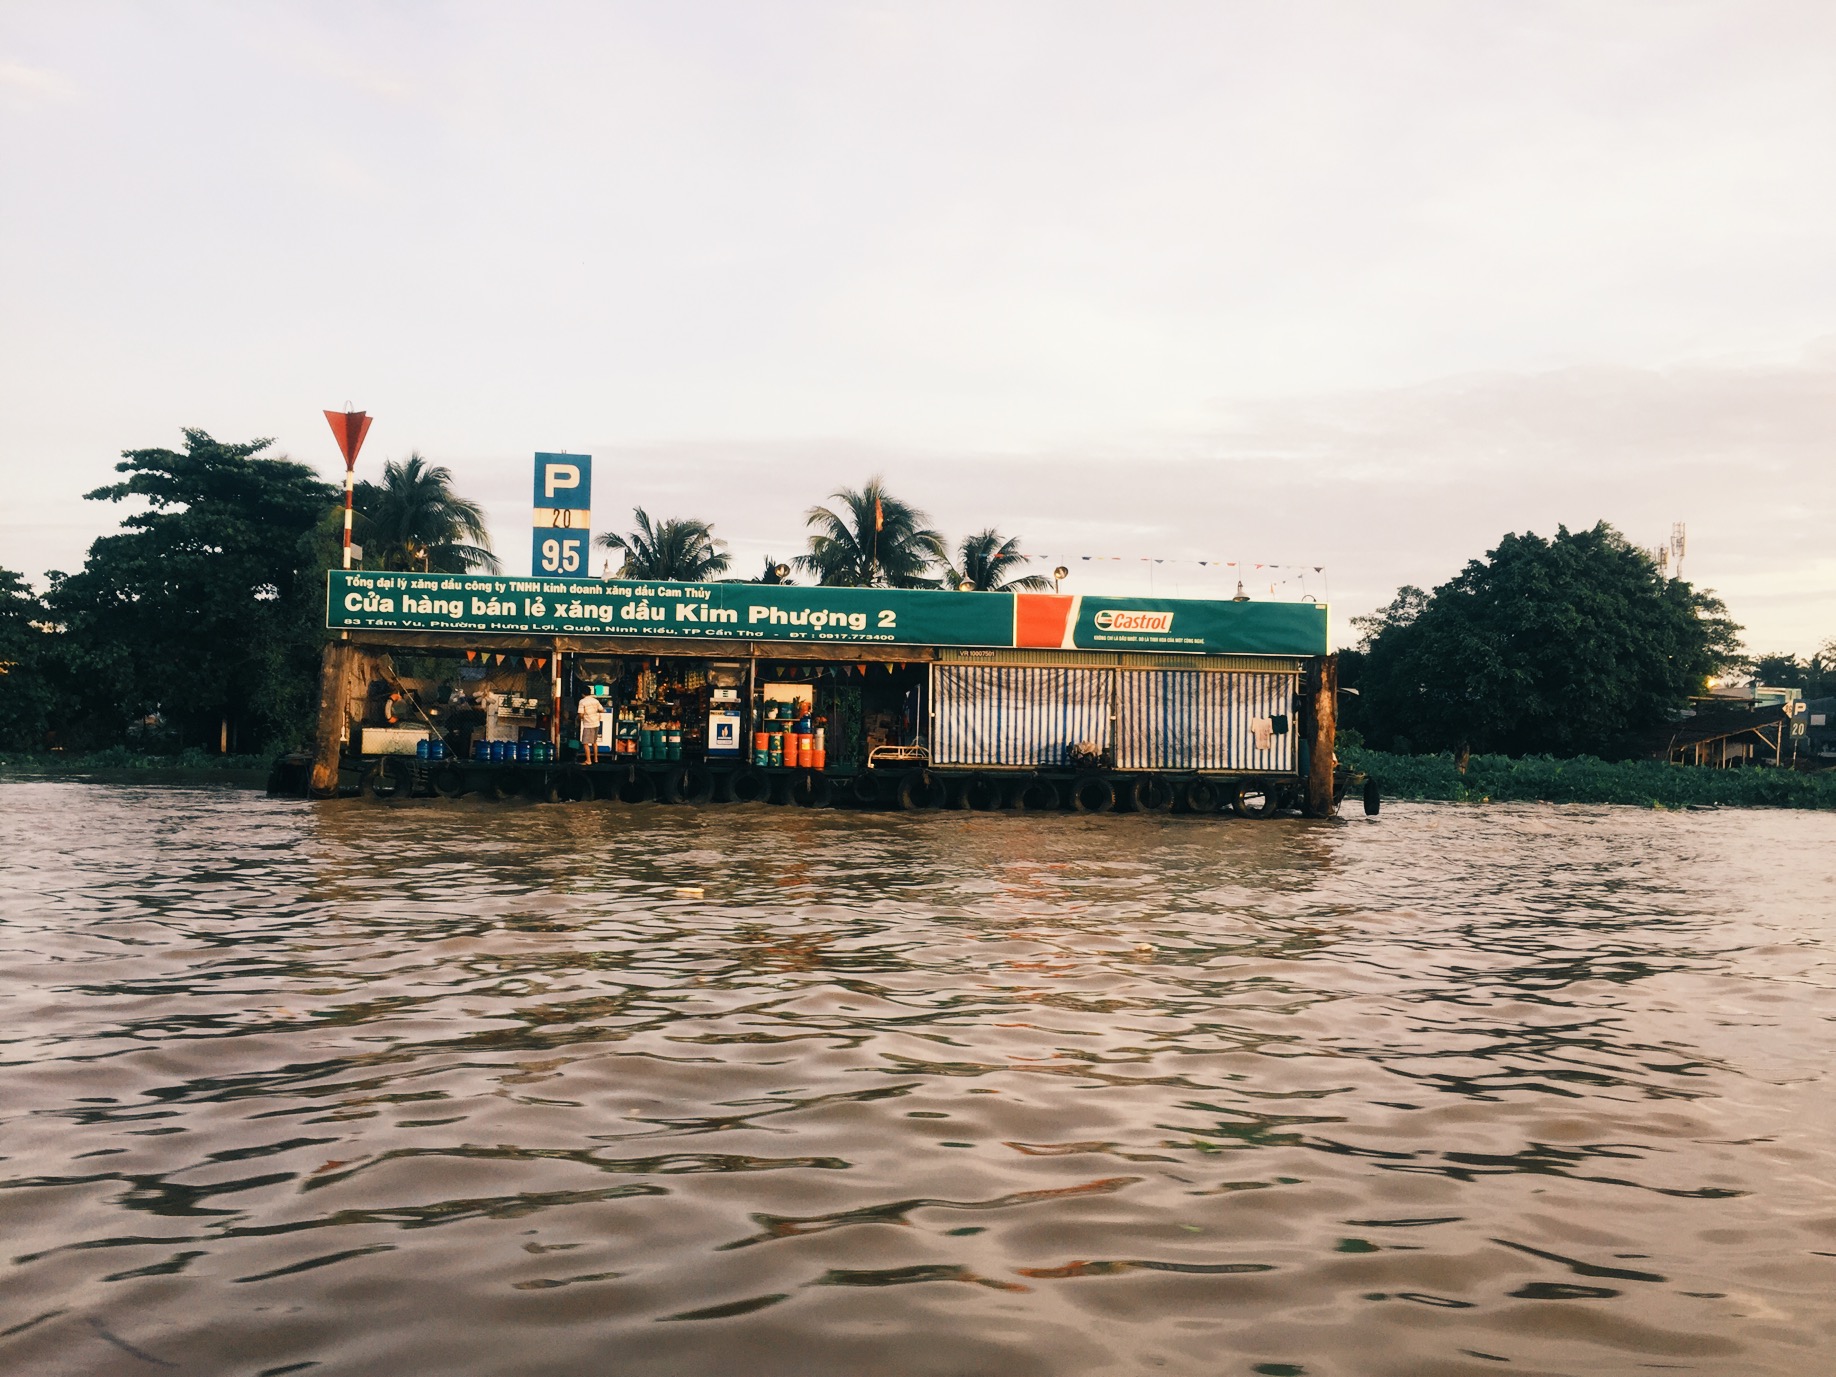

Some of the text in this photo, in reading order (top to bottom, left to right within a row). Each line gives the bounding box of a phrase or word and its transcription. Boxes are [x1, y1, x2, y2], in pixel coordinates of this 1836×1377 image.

[545, 464, 580, 498] P
[552, 508, 571, 528] 20
[541, 539, 580, 574] 9.5
[345, 574, 711, 600] Tổng đại lý xăng dầu công ty TNHH kinh doanh xăng dầu Cam Thủy
[344, 591, 896, 631] Cửa hàng bán lẻ xăng dầu Kim Phượng 2
[1114, 613, 1167, 629] Castrol
[491, 623, 528, 631] Hưng
[1794, 702, 1806, 715] P
[1792, 723, 1805, 736] 20
